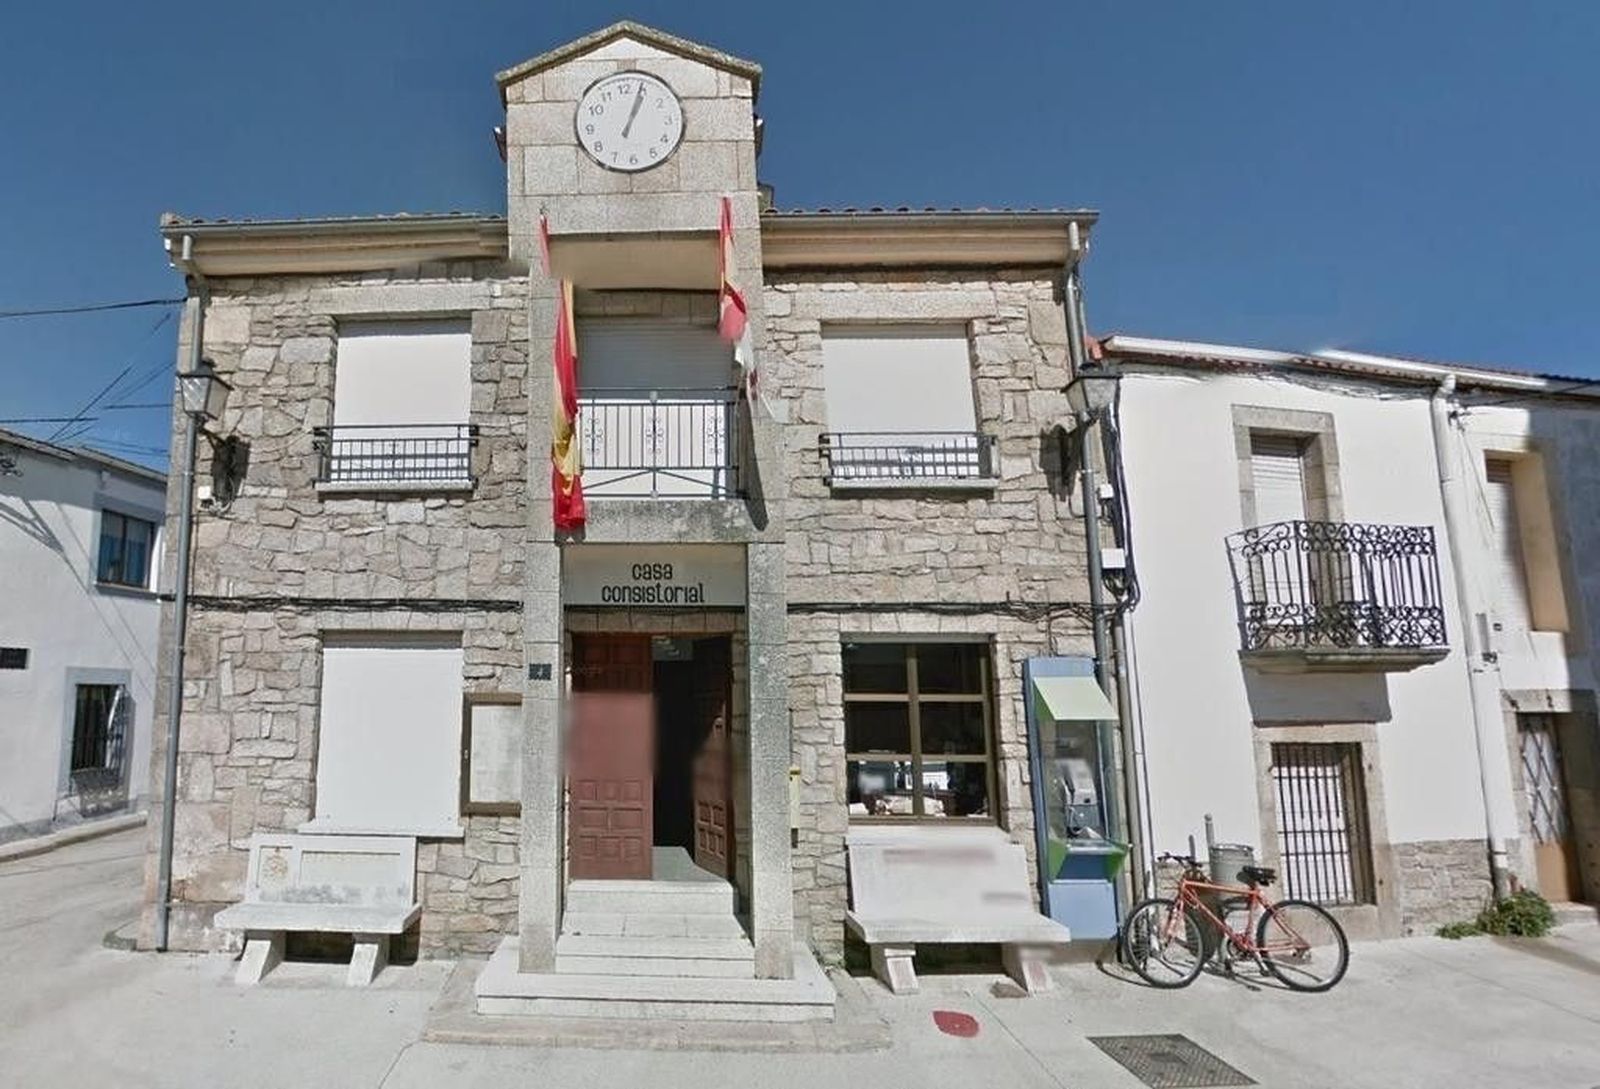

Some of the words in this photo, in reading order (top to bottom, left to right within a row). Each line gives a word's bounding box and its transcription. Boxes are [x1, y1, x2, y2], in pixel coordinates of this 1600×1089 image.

[618, 84, 631, 94] 12
[602, 91, 612, 102] 11
[656, 98, 664, 109] 2
[589, 104, 604, 115] 10
[664, 116, 672, 125] 3
[585, 124, 595, 135] 9
[660, 134, 668, 143] 4
[594, 141, 603, 152] 8
[611, 152, 618, 163] 7
[649, 148, 657, 158] 5
[630, 154, 638, 164] 6
[632, 563, 673, 581] casa
[601, 582, 705, 603] consistorial
